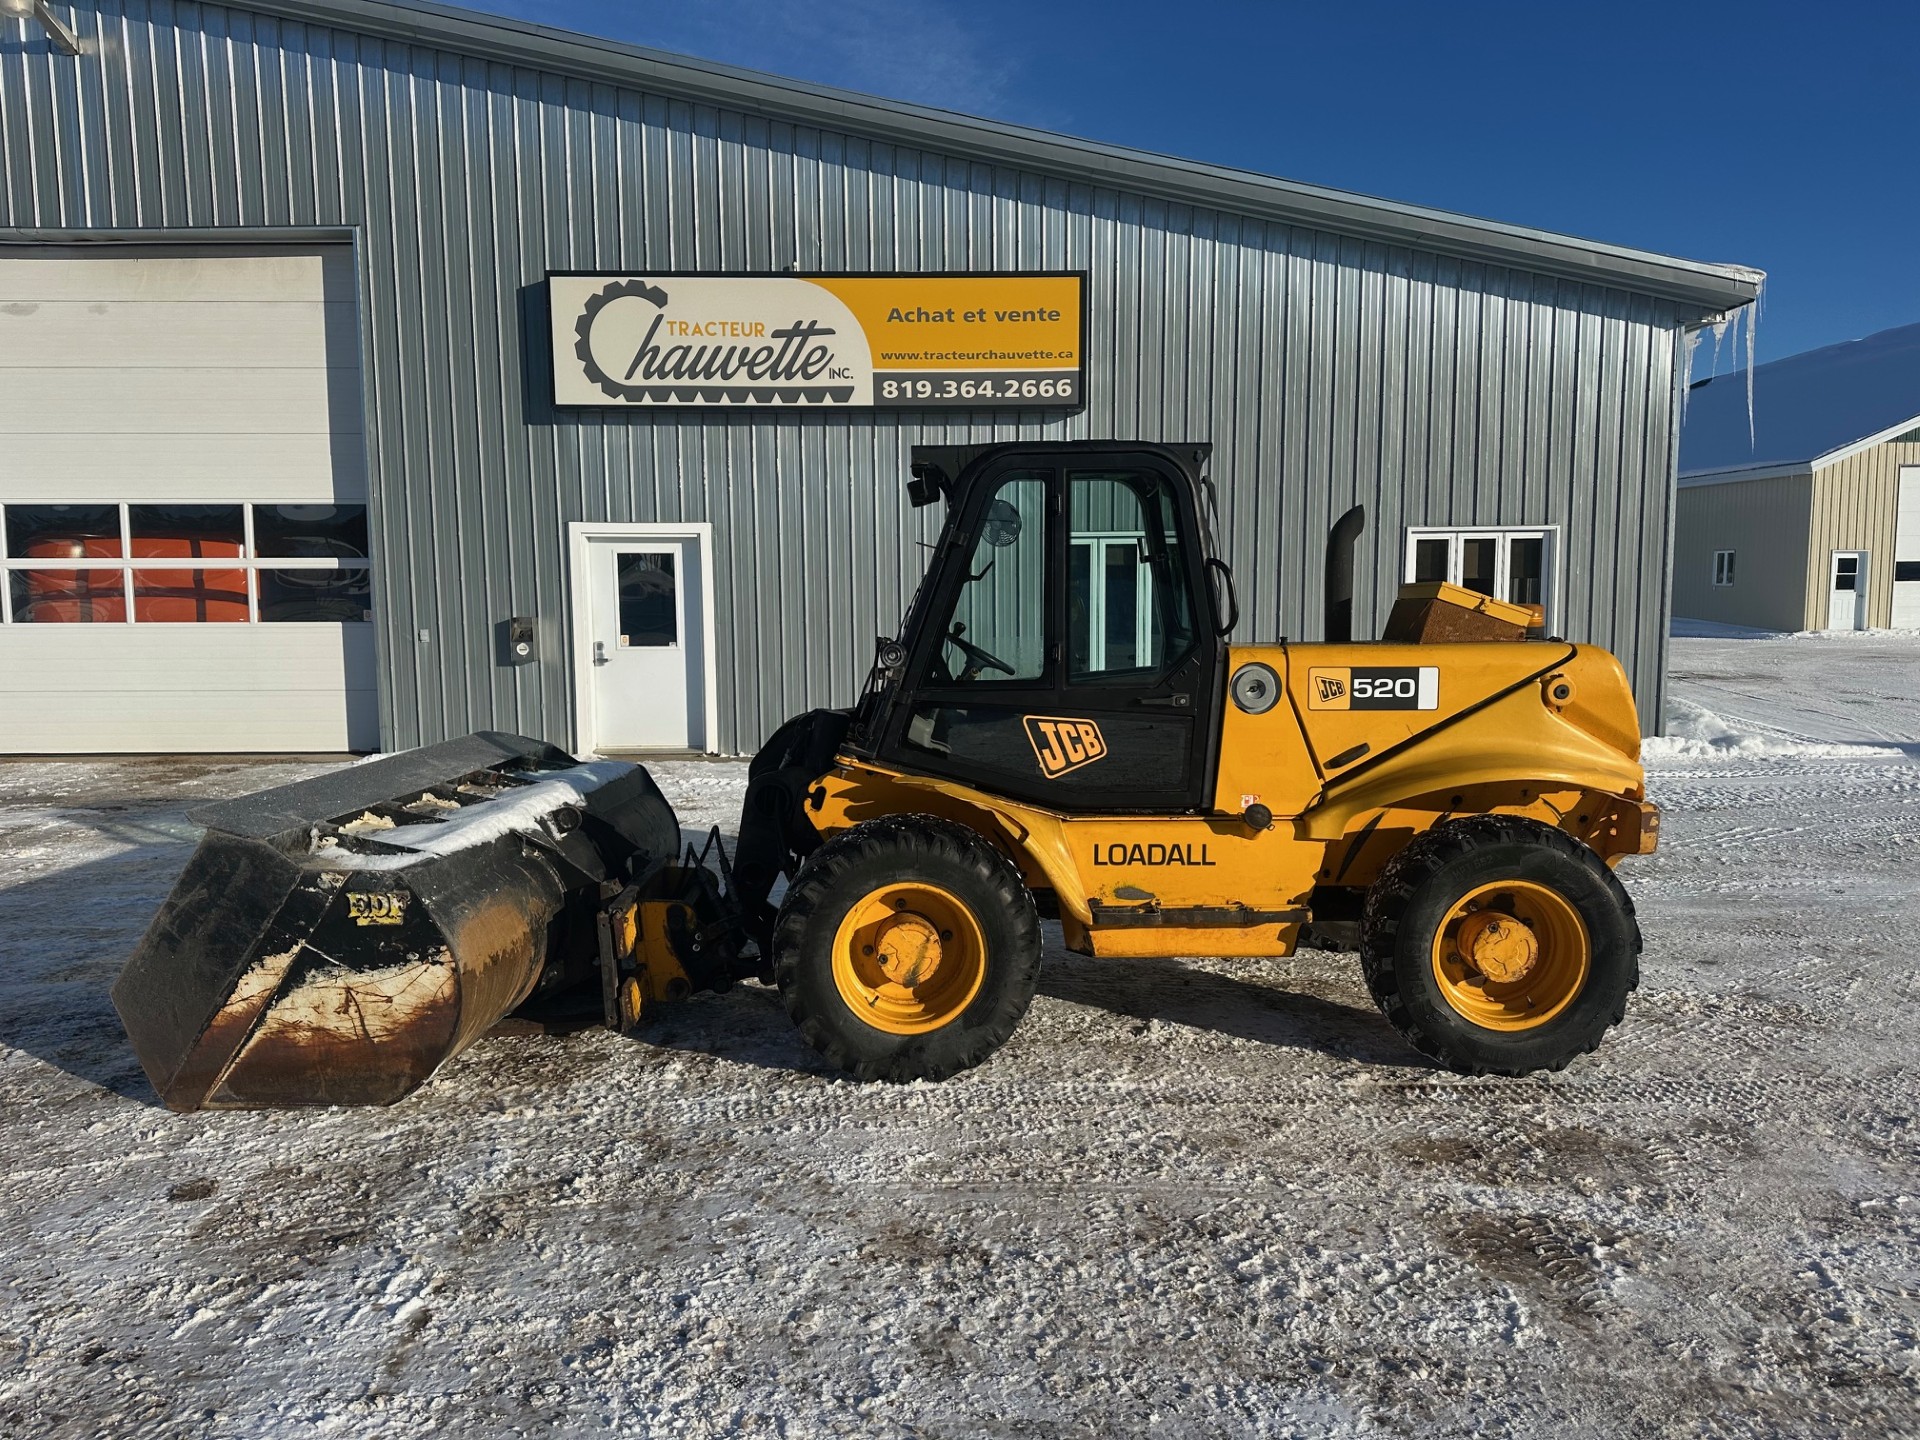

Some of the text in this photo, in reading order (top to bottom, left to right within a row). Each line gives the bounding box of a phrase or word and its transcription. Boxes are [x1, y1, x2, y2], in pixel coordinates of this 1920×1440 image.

[886, 307, 1061, 323] Achat et vente
[666, 320, 766, 338] TRACTEUR
[574, 279, 854, 403] Chauvette INC.
[881, 350, 1074, 360] www.tracteurchauvette.ca
[882, 378, 1073, 398] 819.364.2666
[1320, 678, 1416, 700] JCB 520
[1037, 722, 1102, 771] JCB
[1093, 843, 1217, 866] LOADALL
